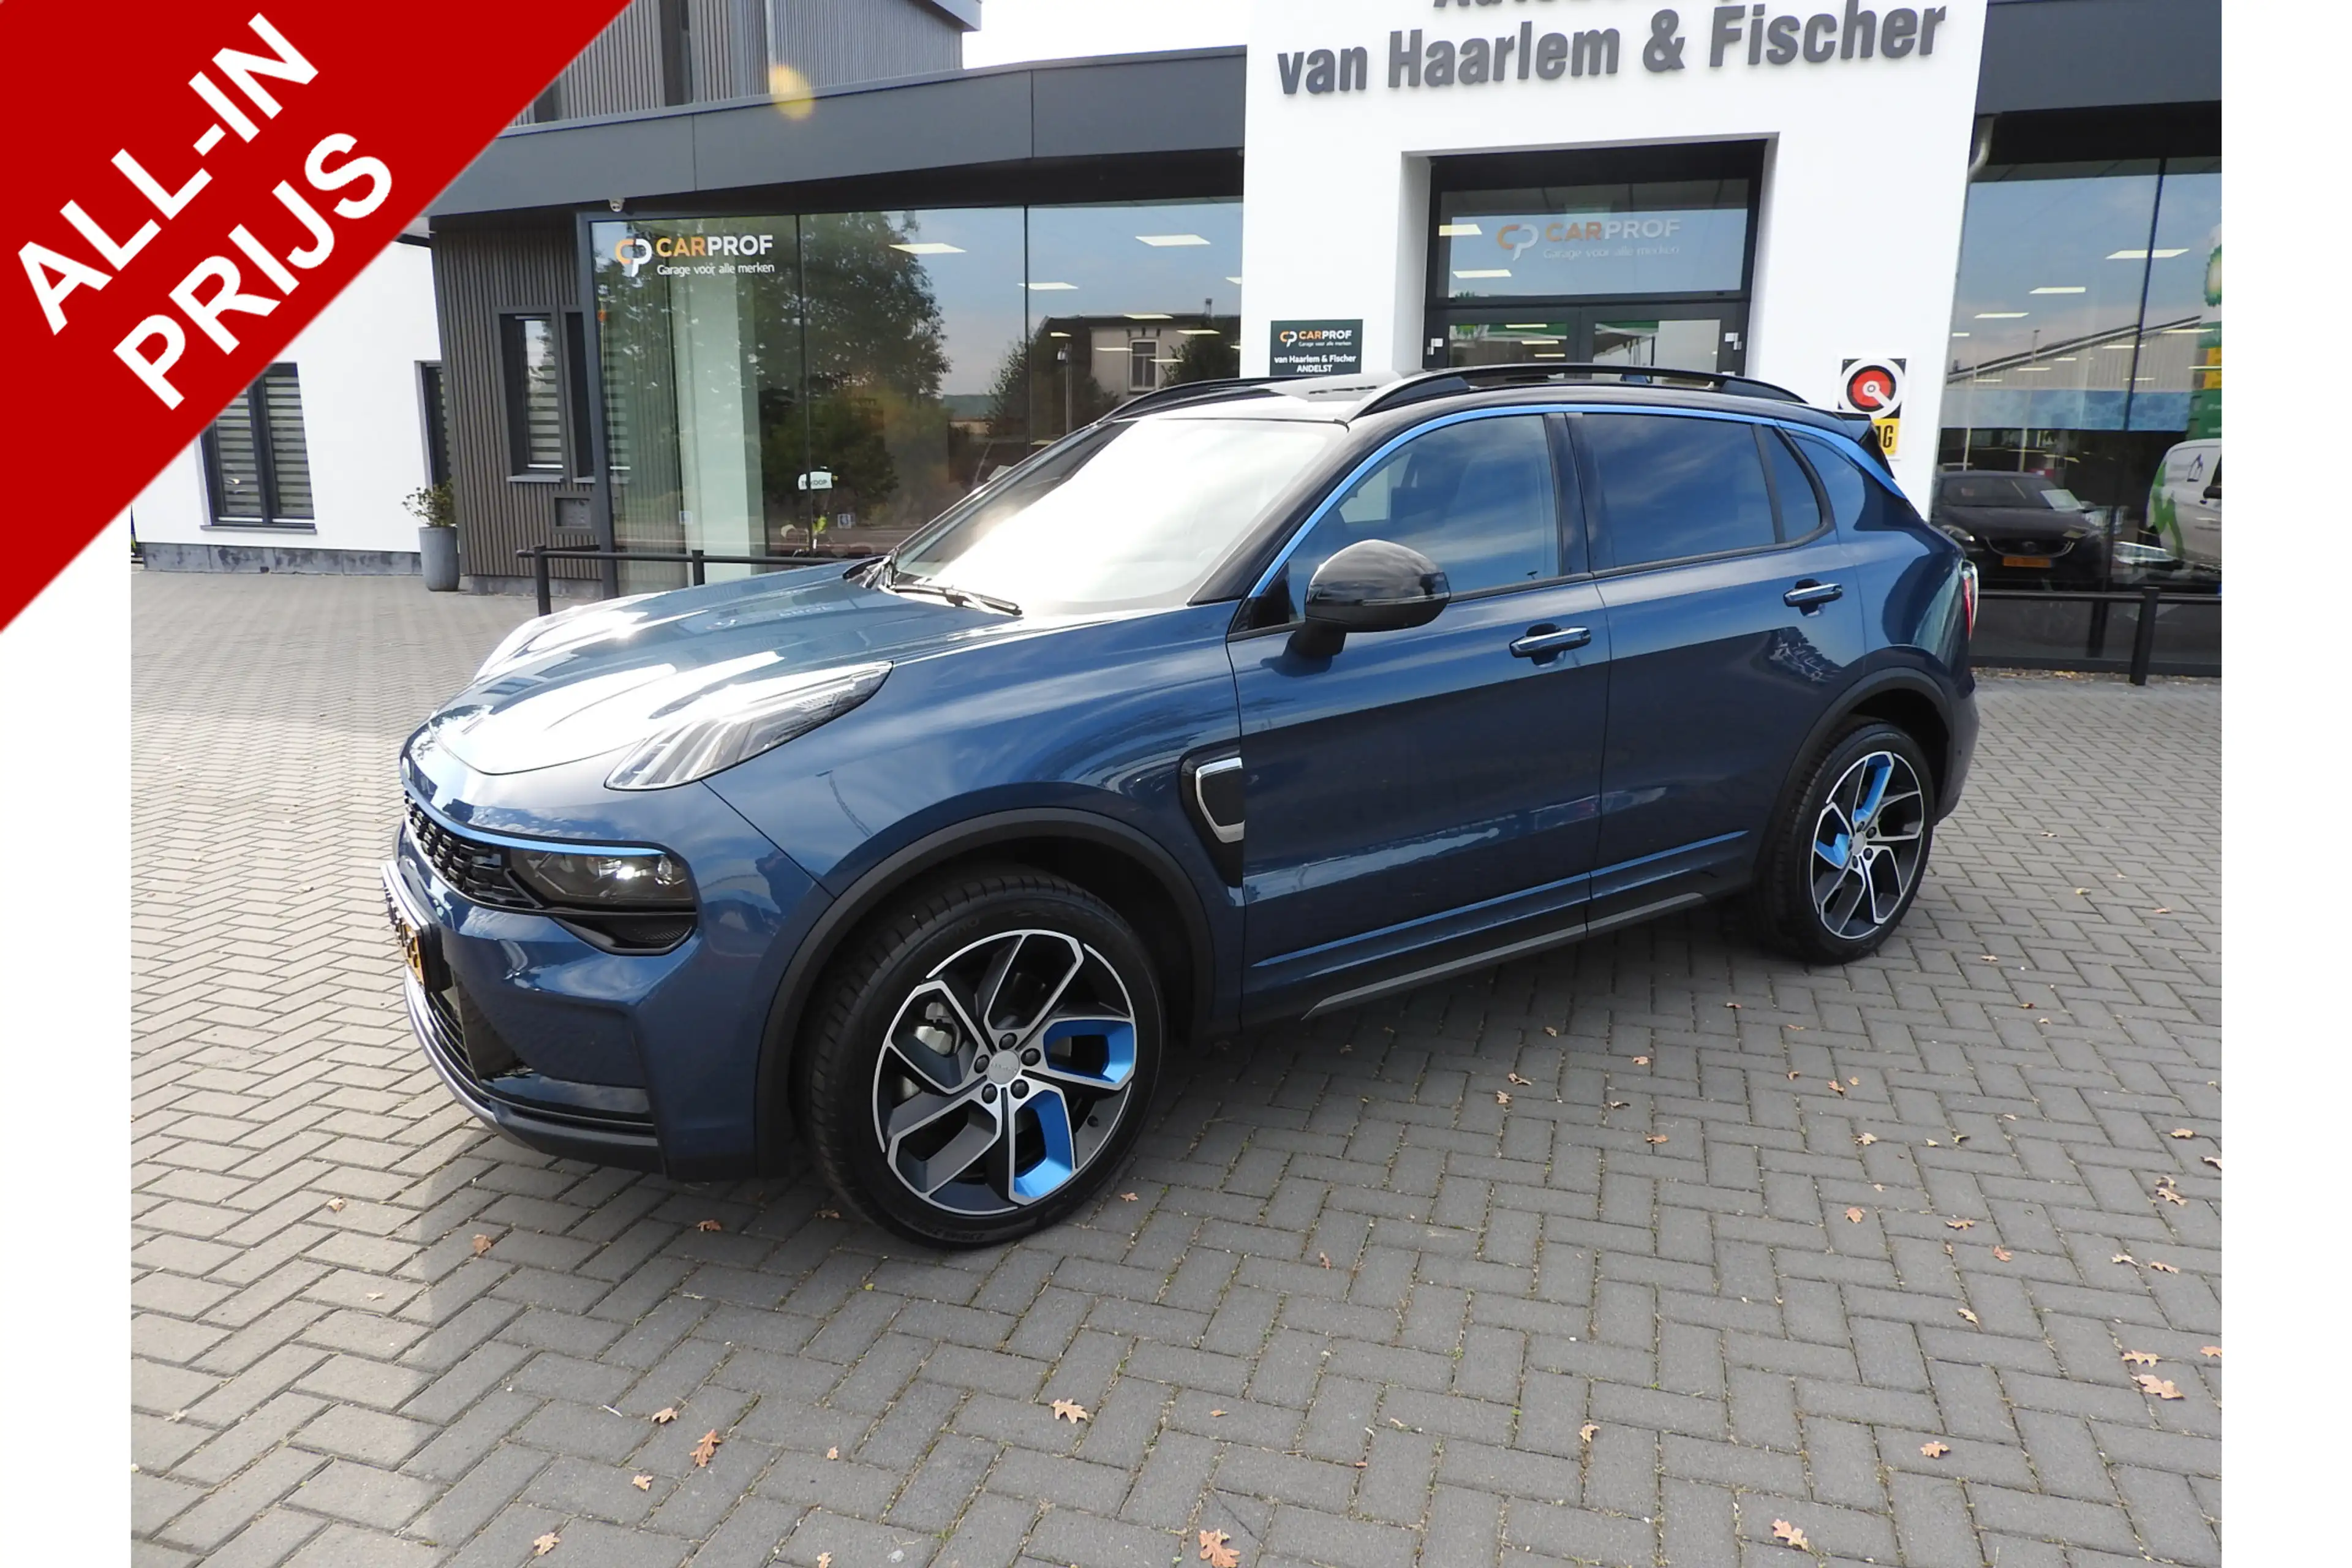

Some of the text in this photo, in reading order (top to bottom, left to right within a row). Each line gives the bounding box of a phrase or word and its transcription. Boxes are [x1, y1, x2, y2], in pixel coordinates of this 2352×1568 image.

[1277, 0, 1947, 94] van Haarlem & Fischer
[1545, 219, 1681, 242] CARPROF
[655, 235, 773, 257] CARPROF
[1543, 248, 1581, 260] Garage
[1586, 249, 1609, 258] voor
[1614, 246, 1634, 256] alle
[657, 264, 690, 277] Garage
[718, 263, 734, 274] alle
[738, 263, 774, 274] merken
[1298, 330, 1352, 340] CARPROF
[1289, 355, 1320, 363] Haarlem
[1329, 353, 1357, 363] Fischer
